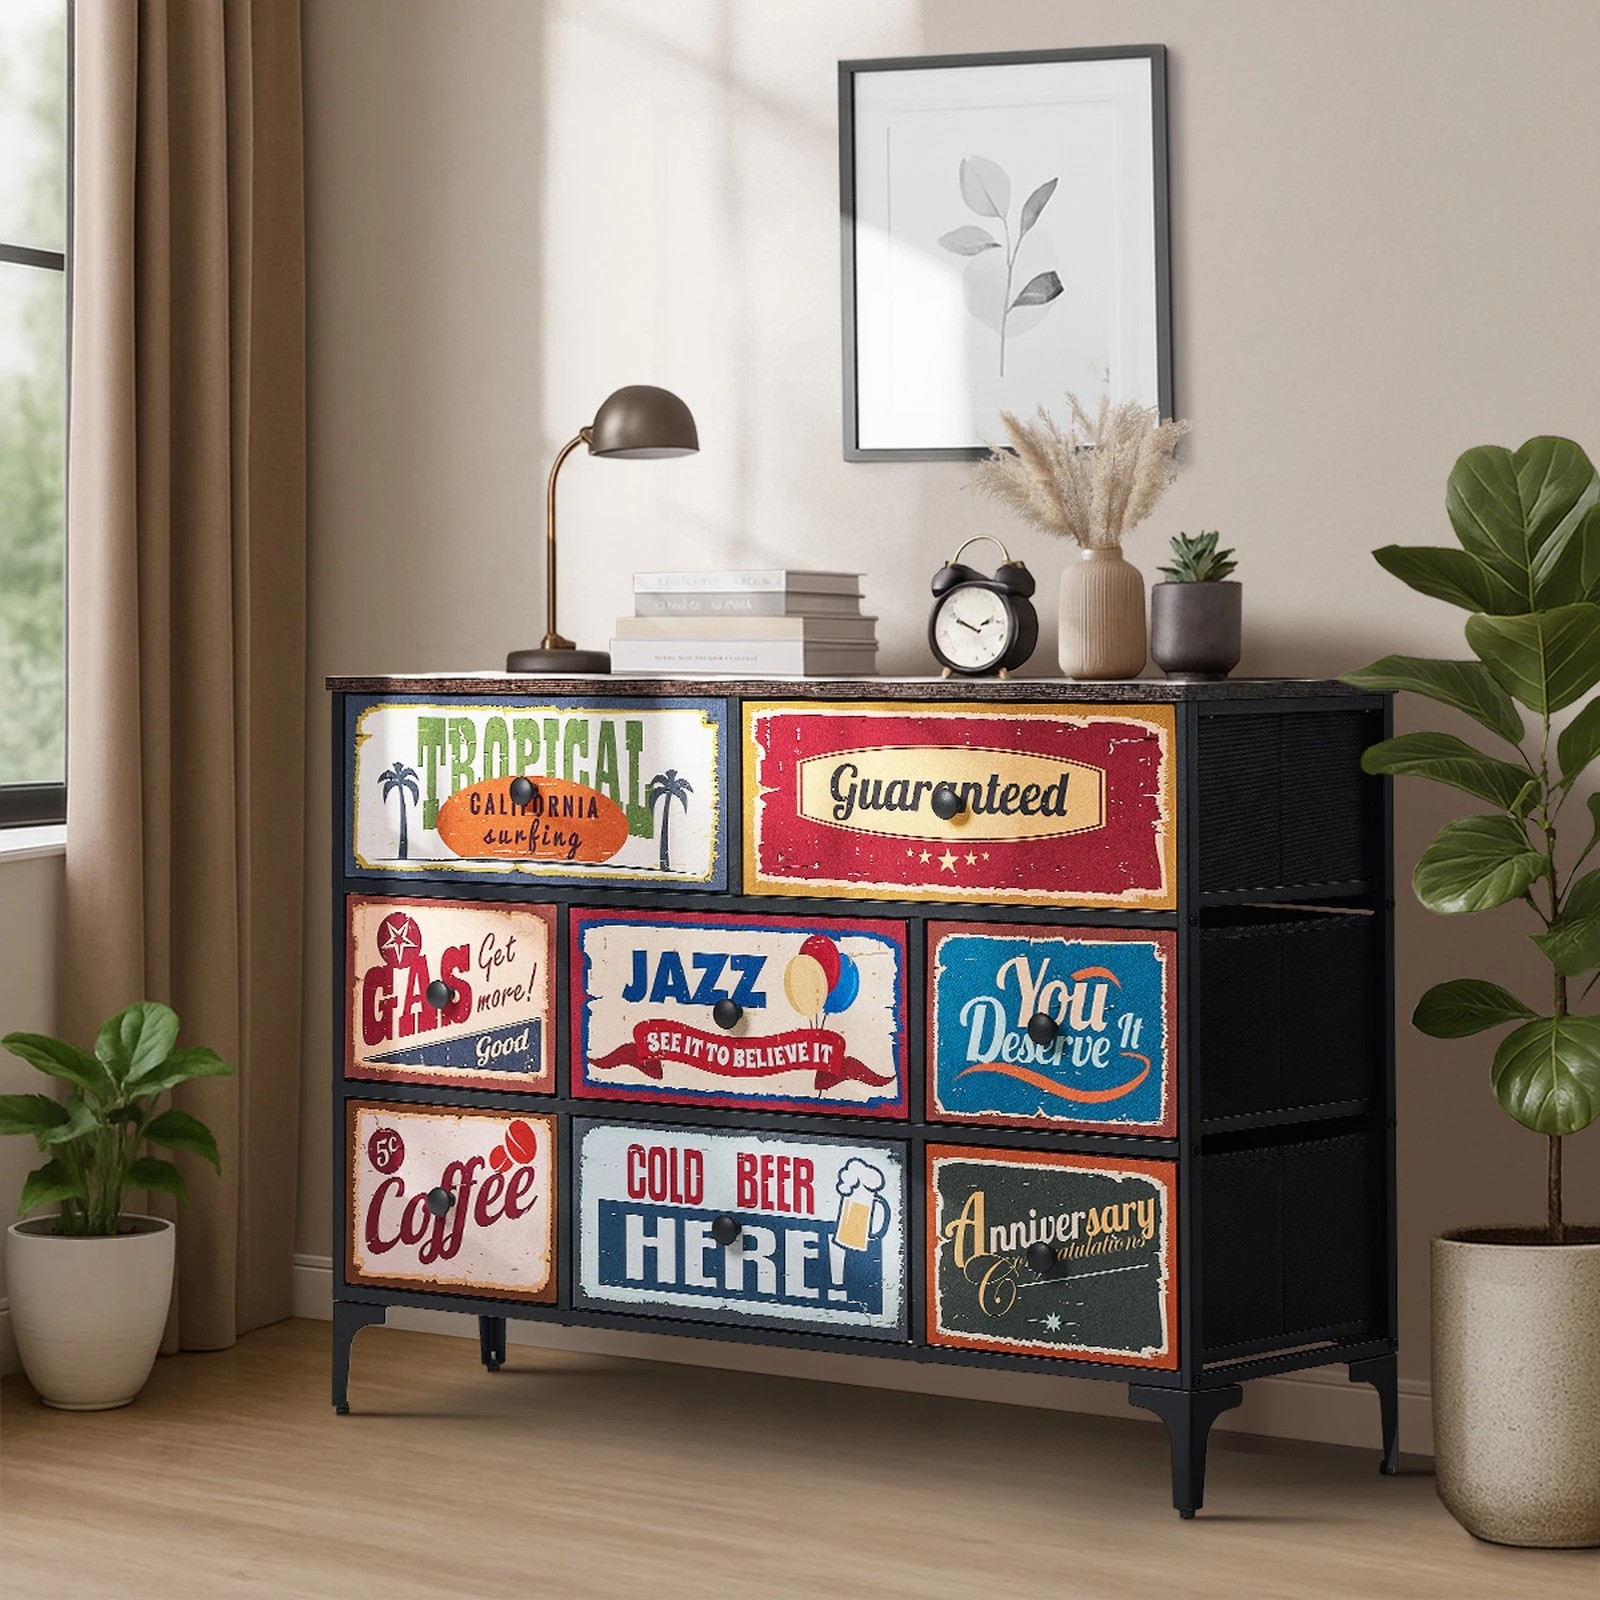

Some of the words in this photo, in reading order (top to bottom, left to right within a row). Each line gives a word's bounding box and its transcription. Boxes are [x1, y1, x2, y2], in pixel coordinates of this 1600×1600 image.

[483, 818, 582, 860] surfing
[478, 932, 517, 982] Get
[622, 949, 767, 1009] JAZZ
[362, 943, 473, 1046] GAS
[477, 962, 537, 1014] more!
[996, 954, 1109, 1033] You
[475, 1028, 530, 1067] Good
[647, 1031, 682, 1052] SEE
[683, 1035, 704, 1058] IT
[706, 1042, 730, 1066] TO
[733, 1041, 809, 1069] BELIEVE
[813, 1042, 833, 1064] IT
[1117, 1012, 1144, 1050] It
[627, 1143, 704, 1206] COLD
[736, 1151, 815, 1215] BEER
[365, 1154, 539, 1265] Coffee
[945, 1190, 1155, 1269] Anniversary
[625, 1213, 848, 1302] HERE!
